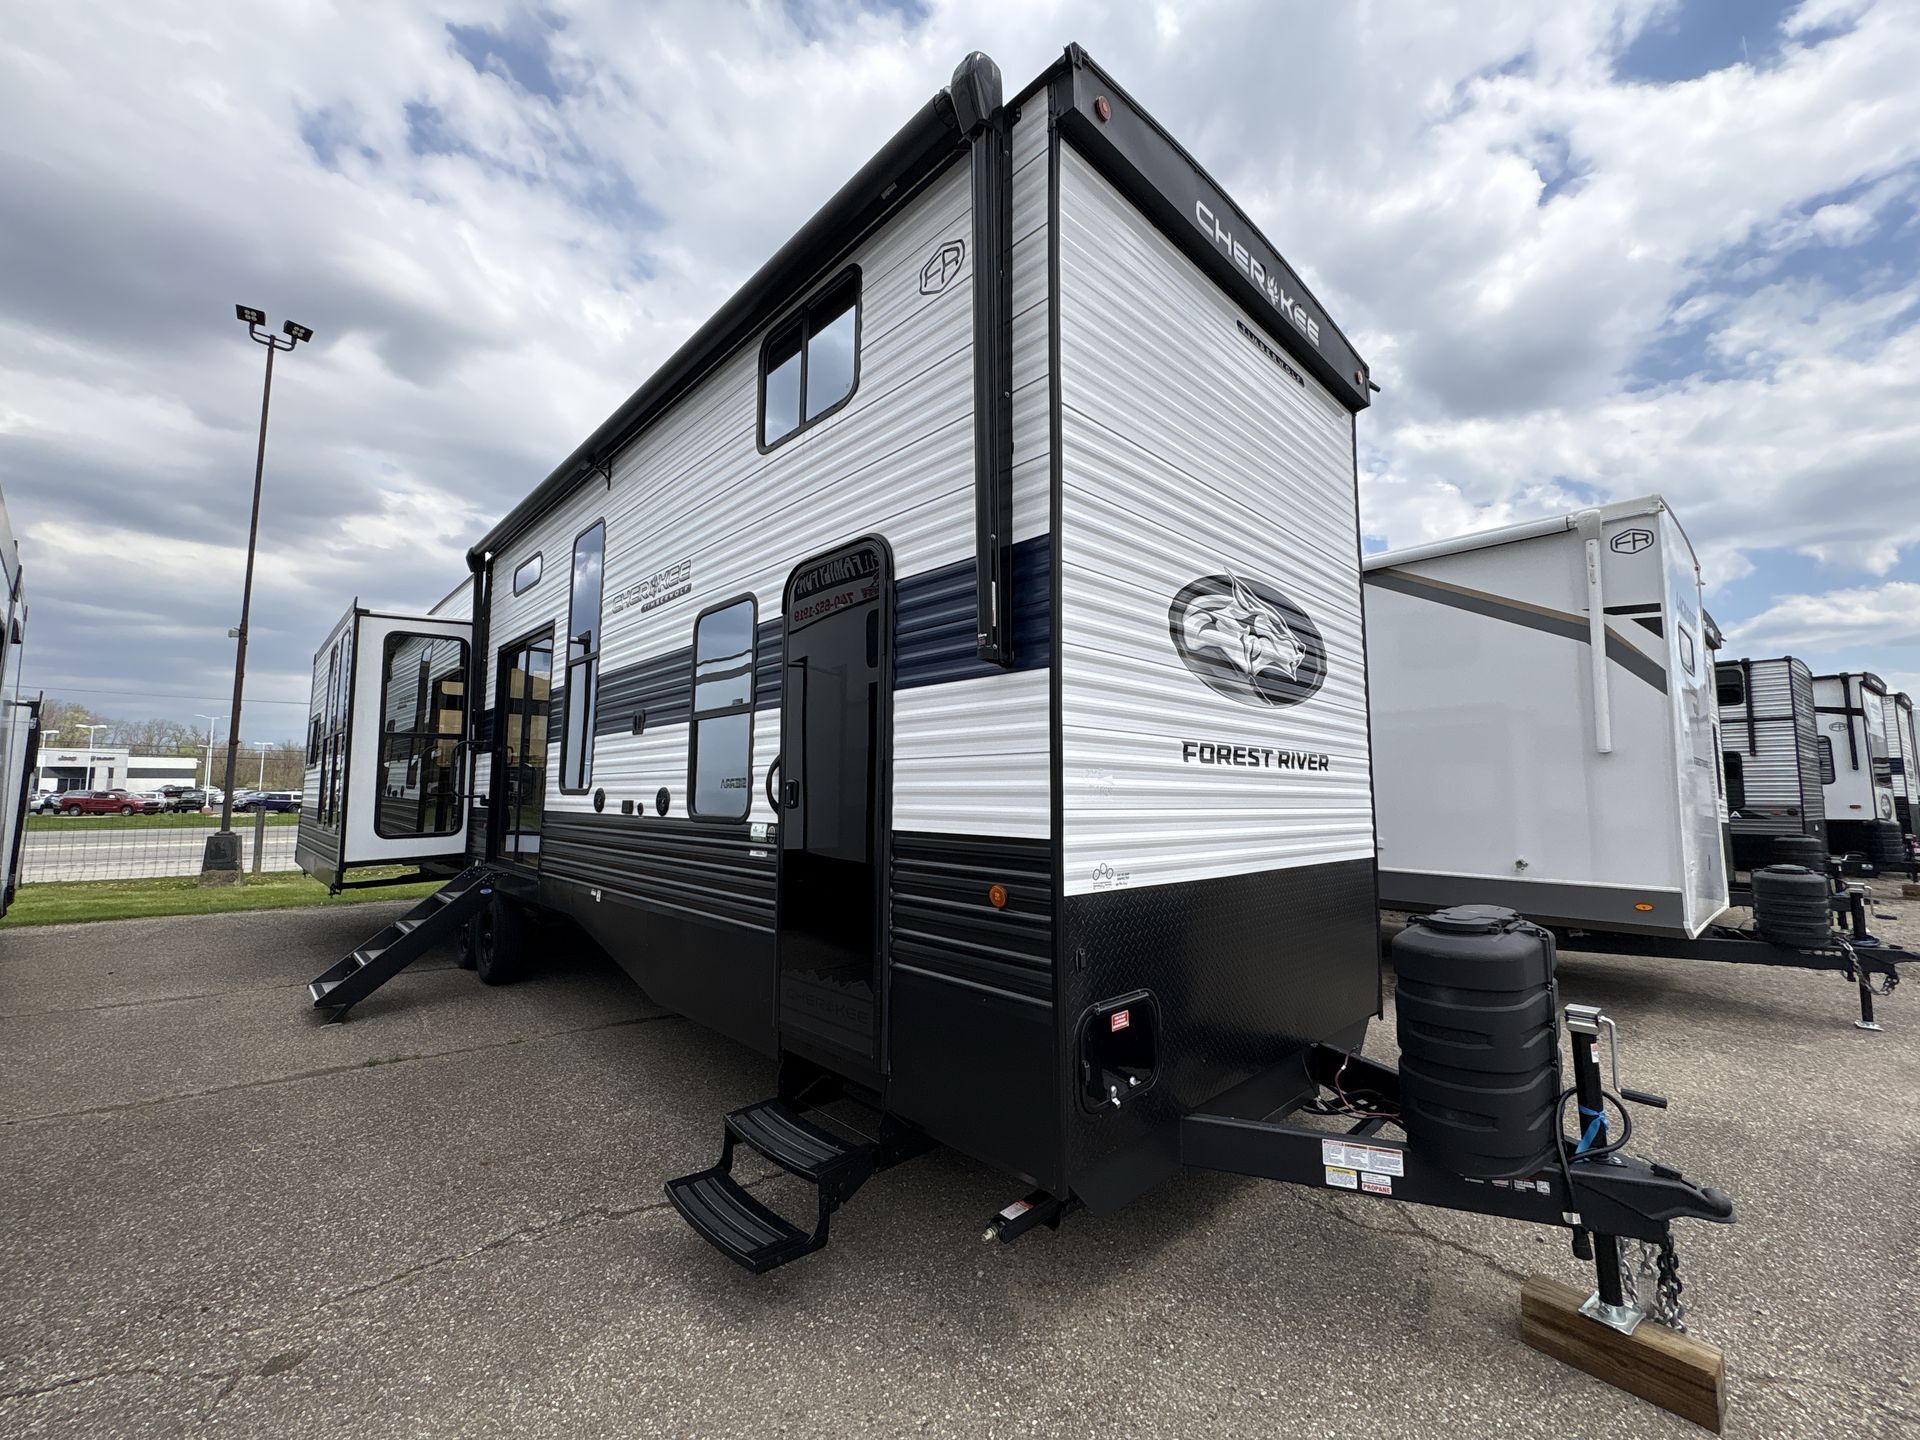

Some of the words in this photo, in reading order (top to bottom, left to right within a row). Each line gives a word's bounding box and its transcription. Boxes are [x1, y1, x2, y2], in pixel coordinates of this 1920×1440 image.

[1181, 741, 1274, 768] FOREST
[1277, 750, 1329, 771] RIVER
[1363, 1184, 1391, 1194] PROPANE
